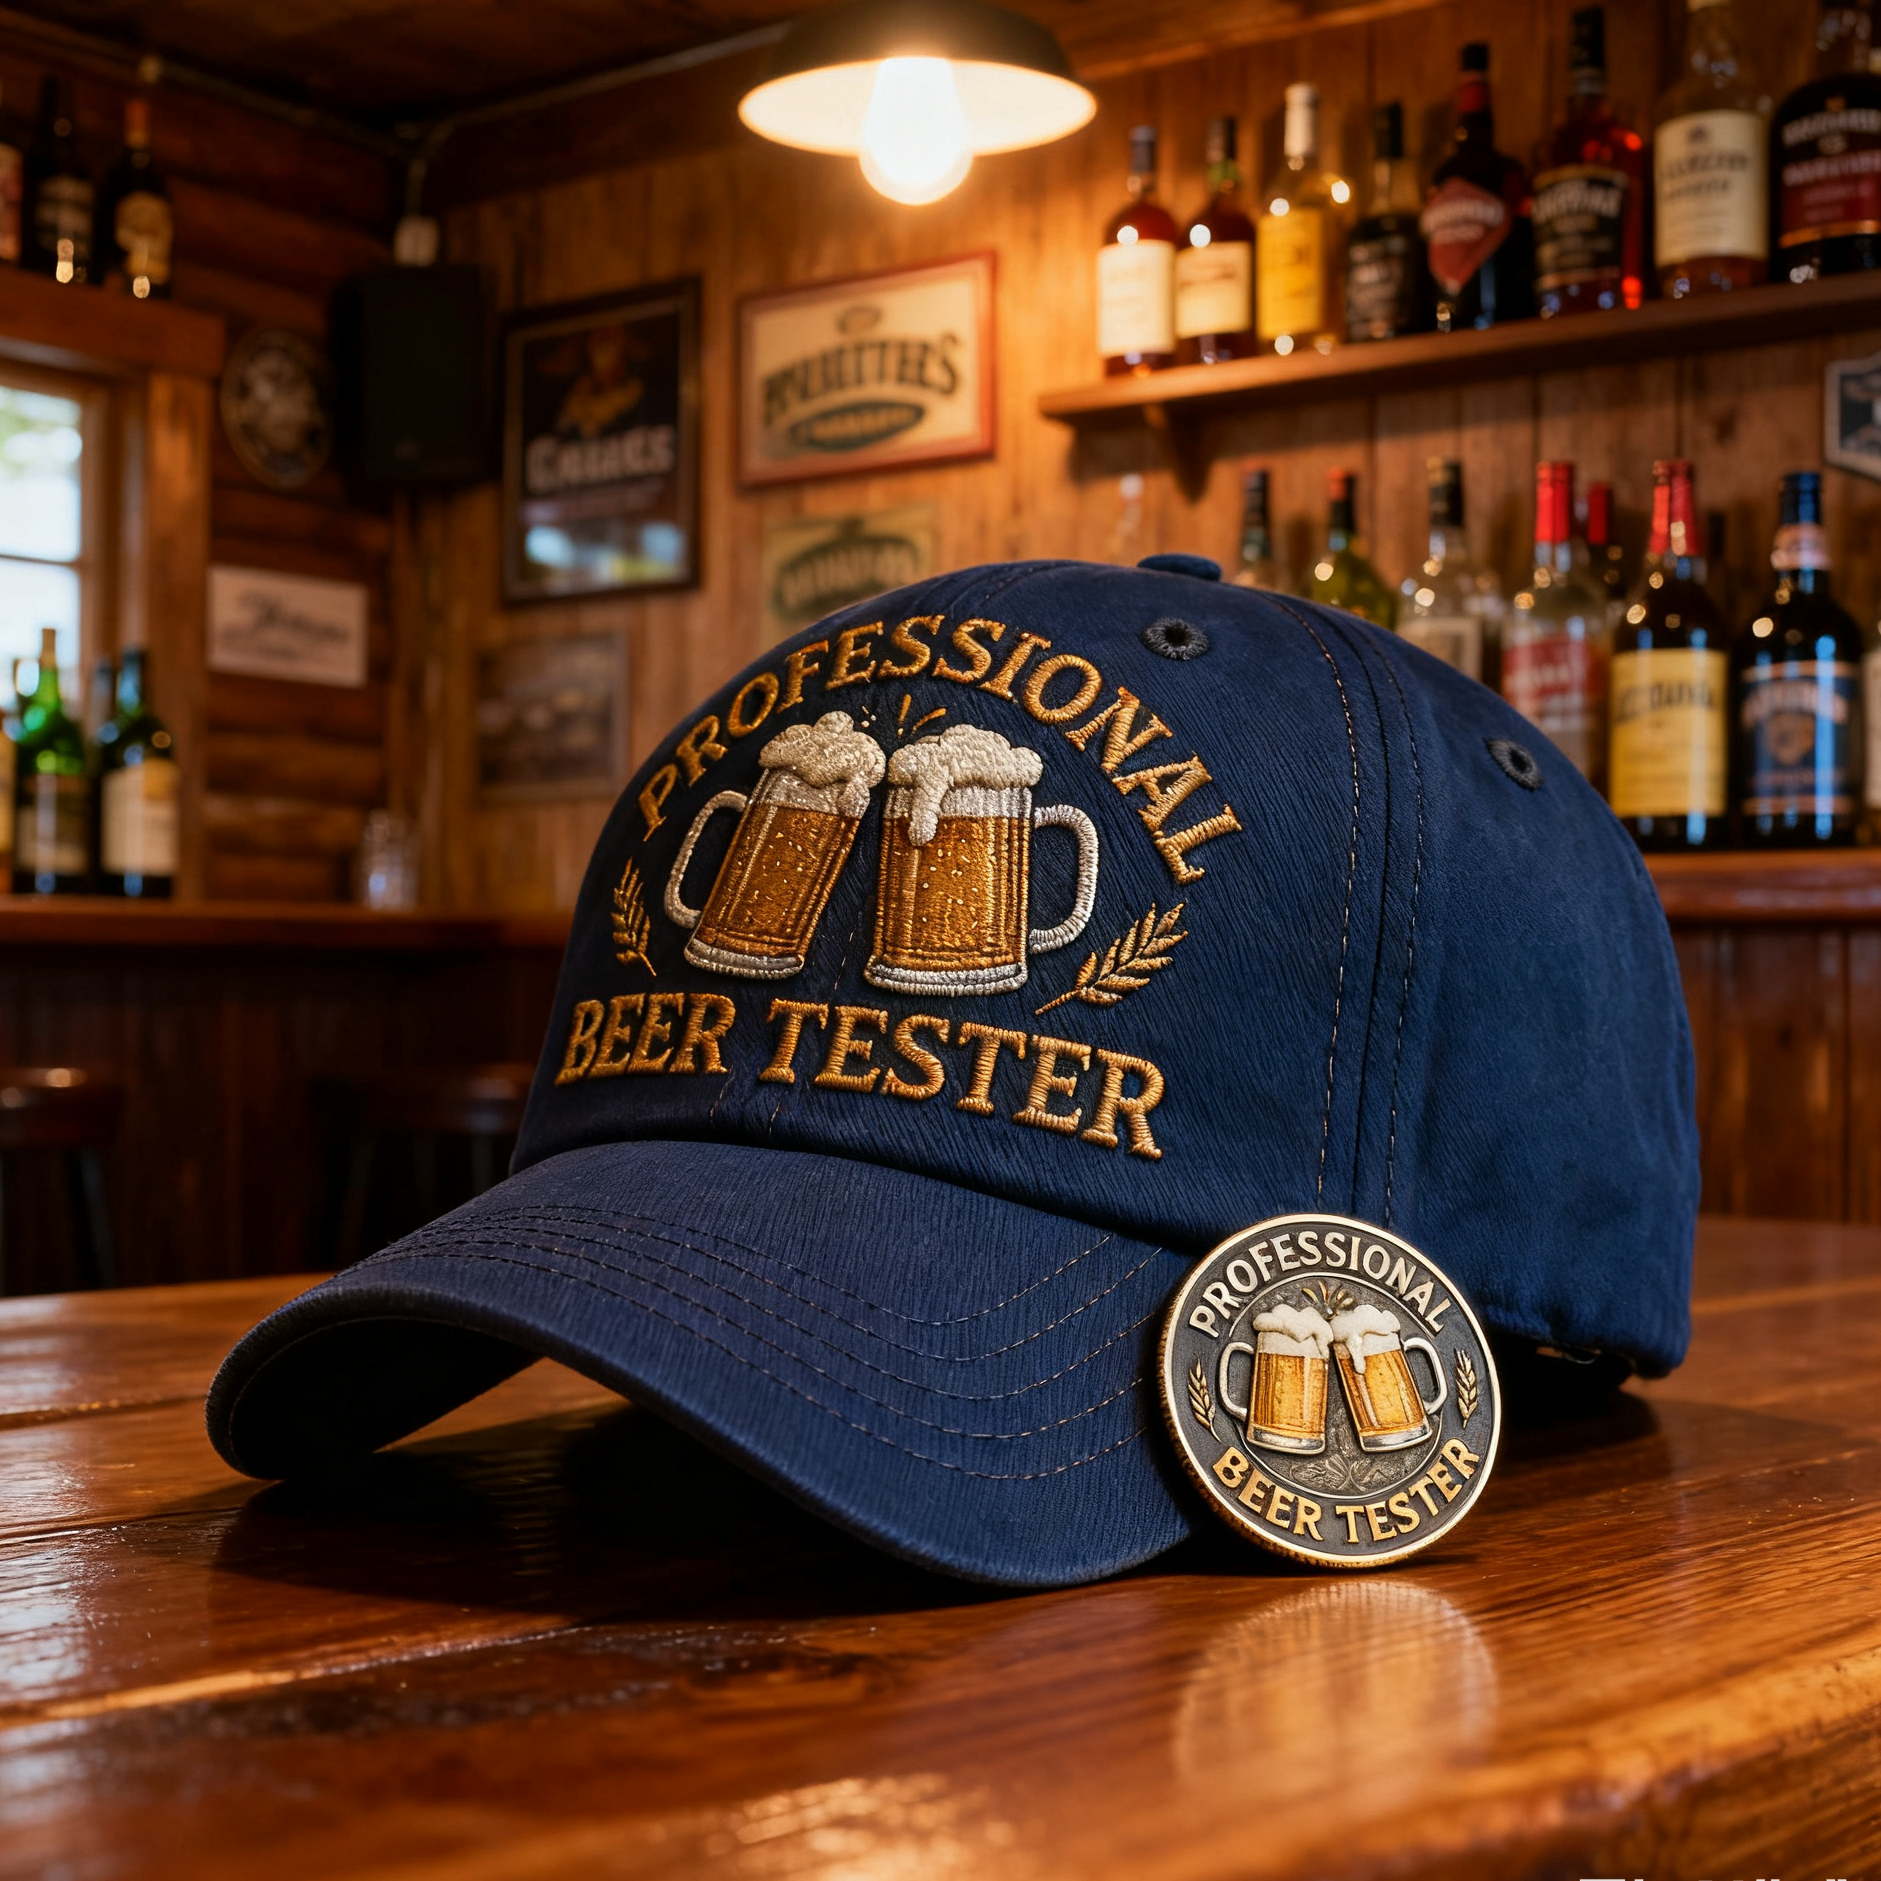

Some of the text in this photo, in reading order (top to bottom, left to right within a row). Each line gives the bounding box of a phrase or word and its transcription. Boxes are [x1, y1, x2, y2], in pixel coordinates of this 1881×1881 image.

[638, 614, 1243, 885] PROFESSIONAL
[554, 992, 1166, 1161] BEER TESTER
[1188, 1230, 1452, 1339] PROFESSIONAL
[1212, 1437, 1481, 1544] BEER TESTER
